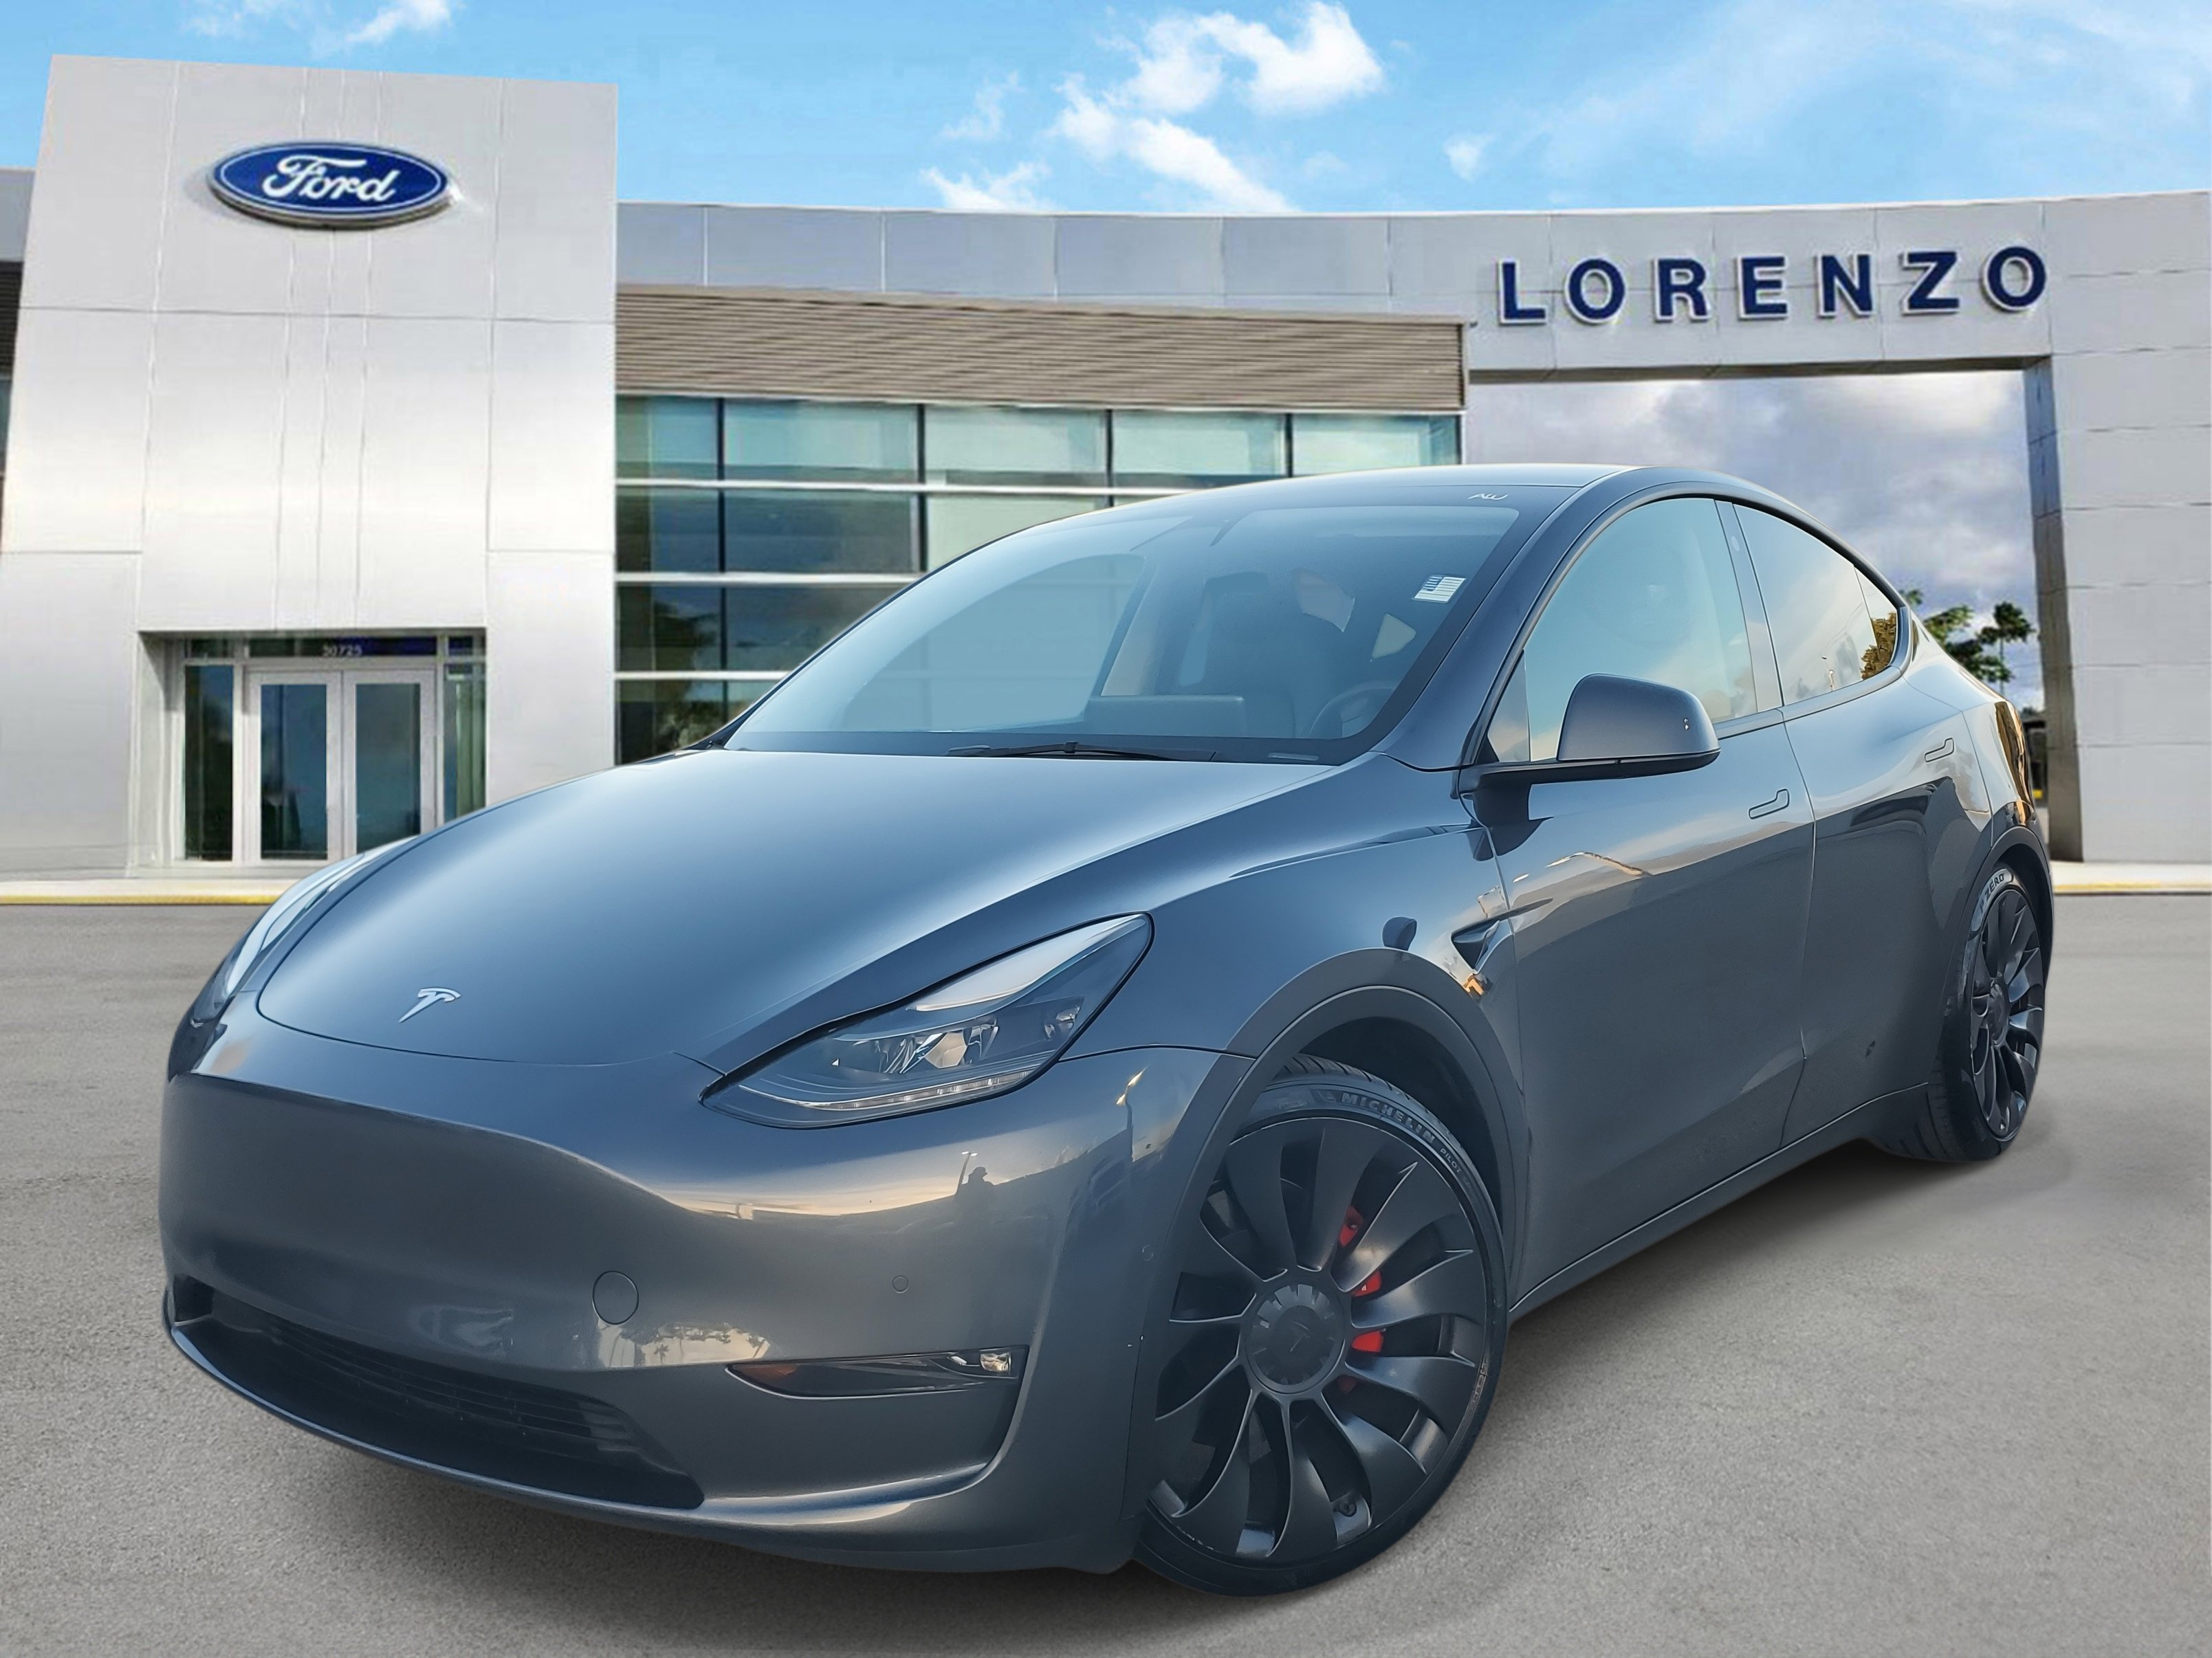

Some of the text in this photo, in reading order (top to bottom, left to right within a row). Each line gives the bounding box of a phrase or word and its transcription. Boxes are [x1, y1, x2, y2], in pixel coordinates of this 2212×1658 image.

[263, 155, 400, 201] Ford
[1498, 245, 2048, 325] LORENZO
[1985, 874, 2005, 900] ZERO
[1341, 1092, 1462, 1173] MICHELIN PILOT
